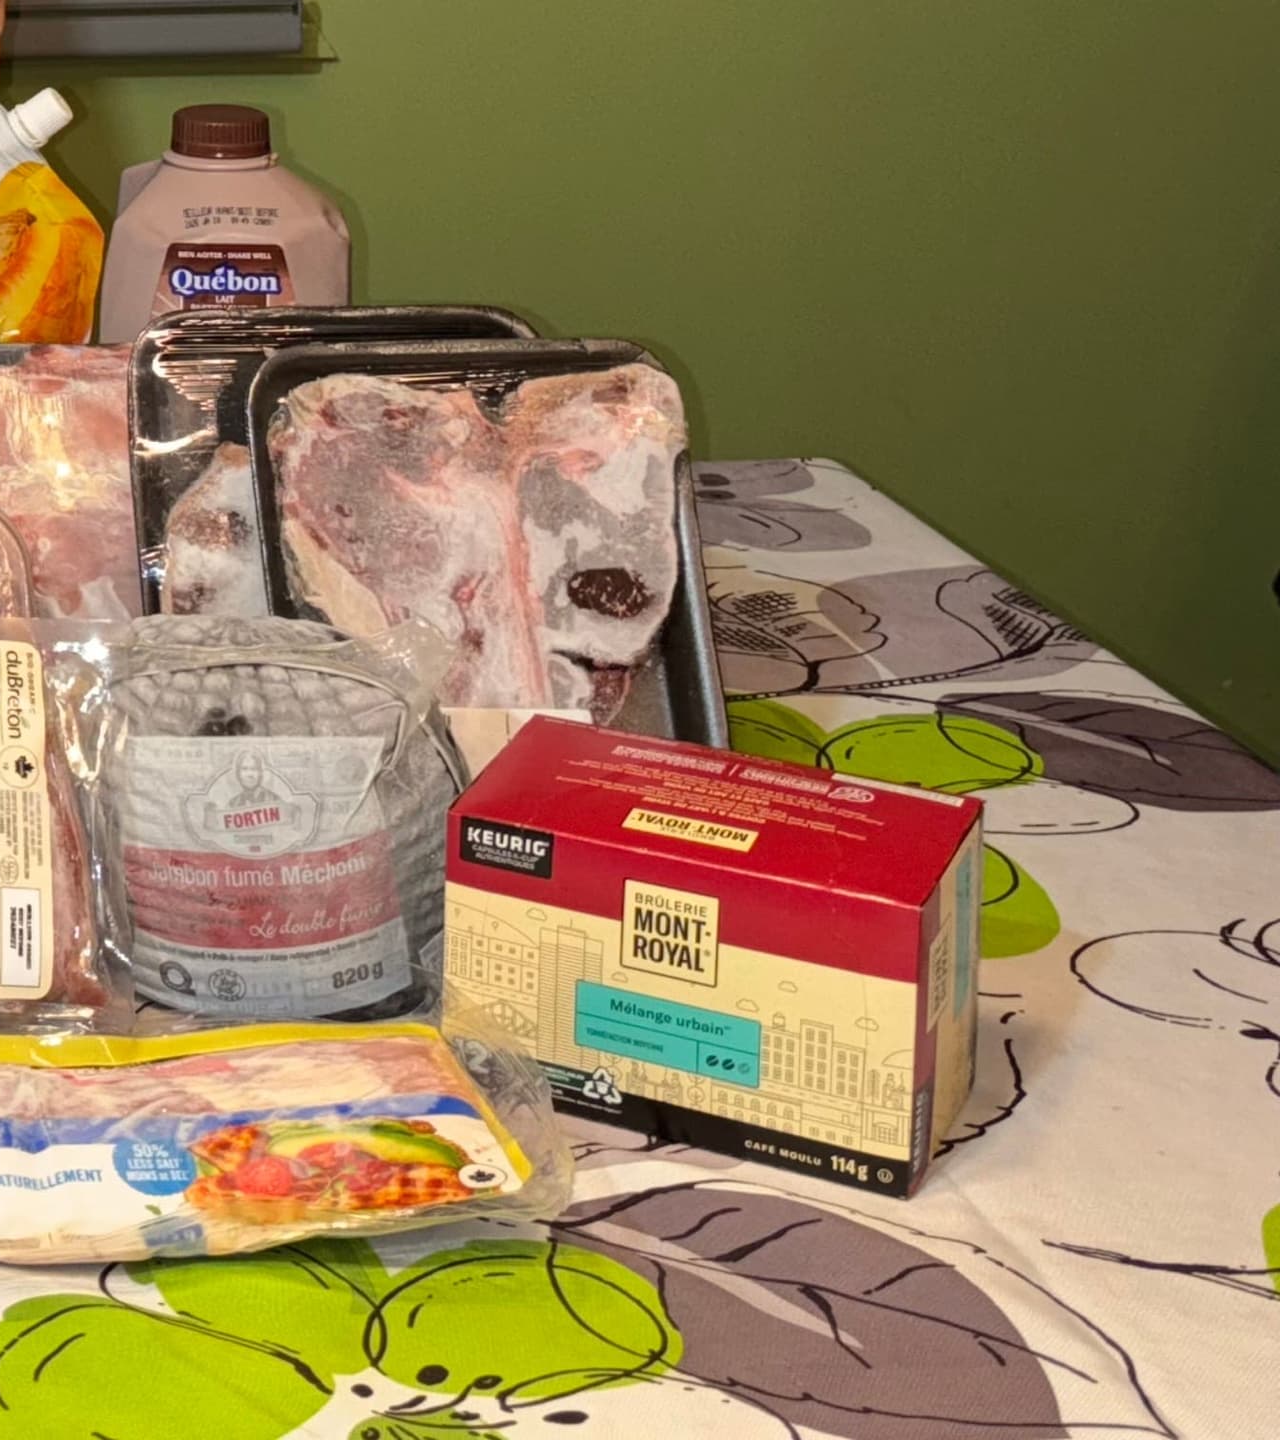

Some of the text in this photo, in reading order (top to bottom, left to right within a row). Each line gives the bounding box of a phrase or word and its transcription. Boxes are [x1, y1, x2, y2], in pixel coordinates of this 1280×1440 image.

[171, 266, 279, 294] Québon
[6, 649, 24, 740] duBreton
[223, 807, 281, 830] FORTIN
[467, 827, 549, 857] KEURIG
[147, 862, 219, 887] Jambon
[223, 862, 274, 885] fumé
[635, 892, 708, 918] BRÛLERIE
[249, 912, 277, 939] Le
[279, 908, 335, 937] double
[634, 906, 712, 944] MONT-
[632, 934, 705, 973] ROYAL
[332, 960, 384, 990] 820 g
[609, 998, 725, 1037] Mélange urbain
[126, 1159, 181, 1171] LESS SALT
[133, 1144, 169, 1159] 50%
[744, 1140, 822, 1166] CAFÉ MOULU
